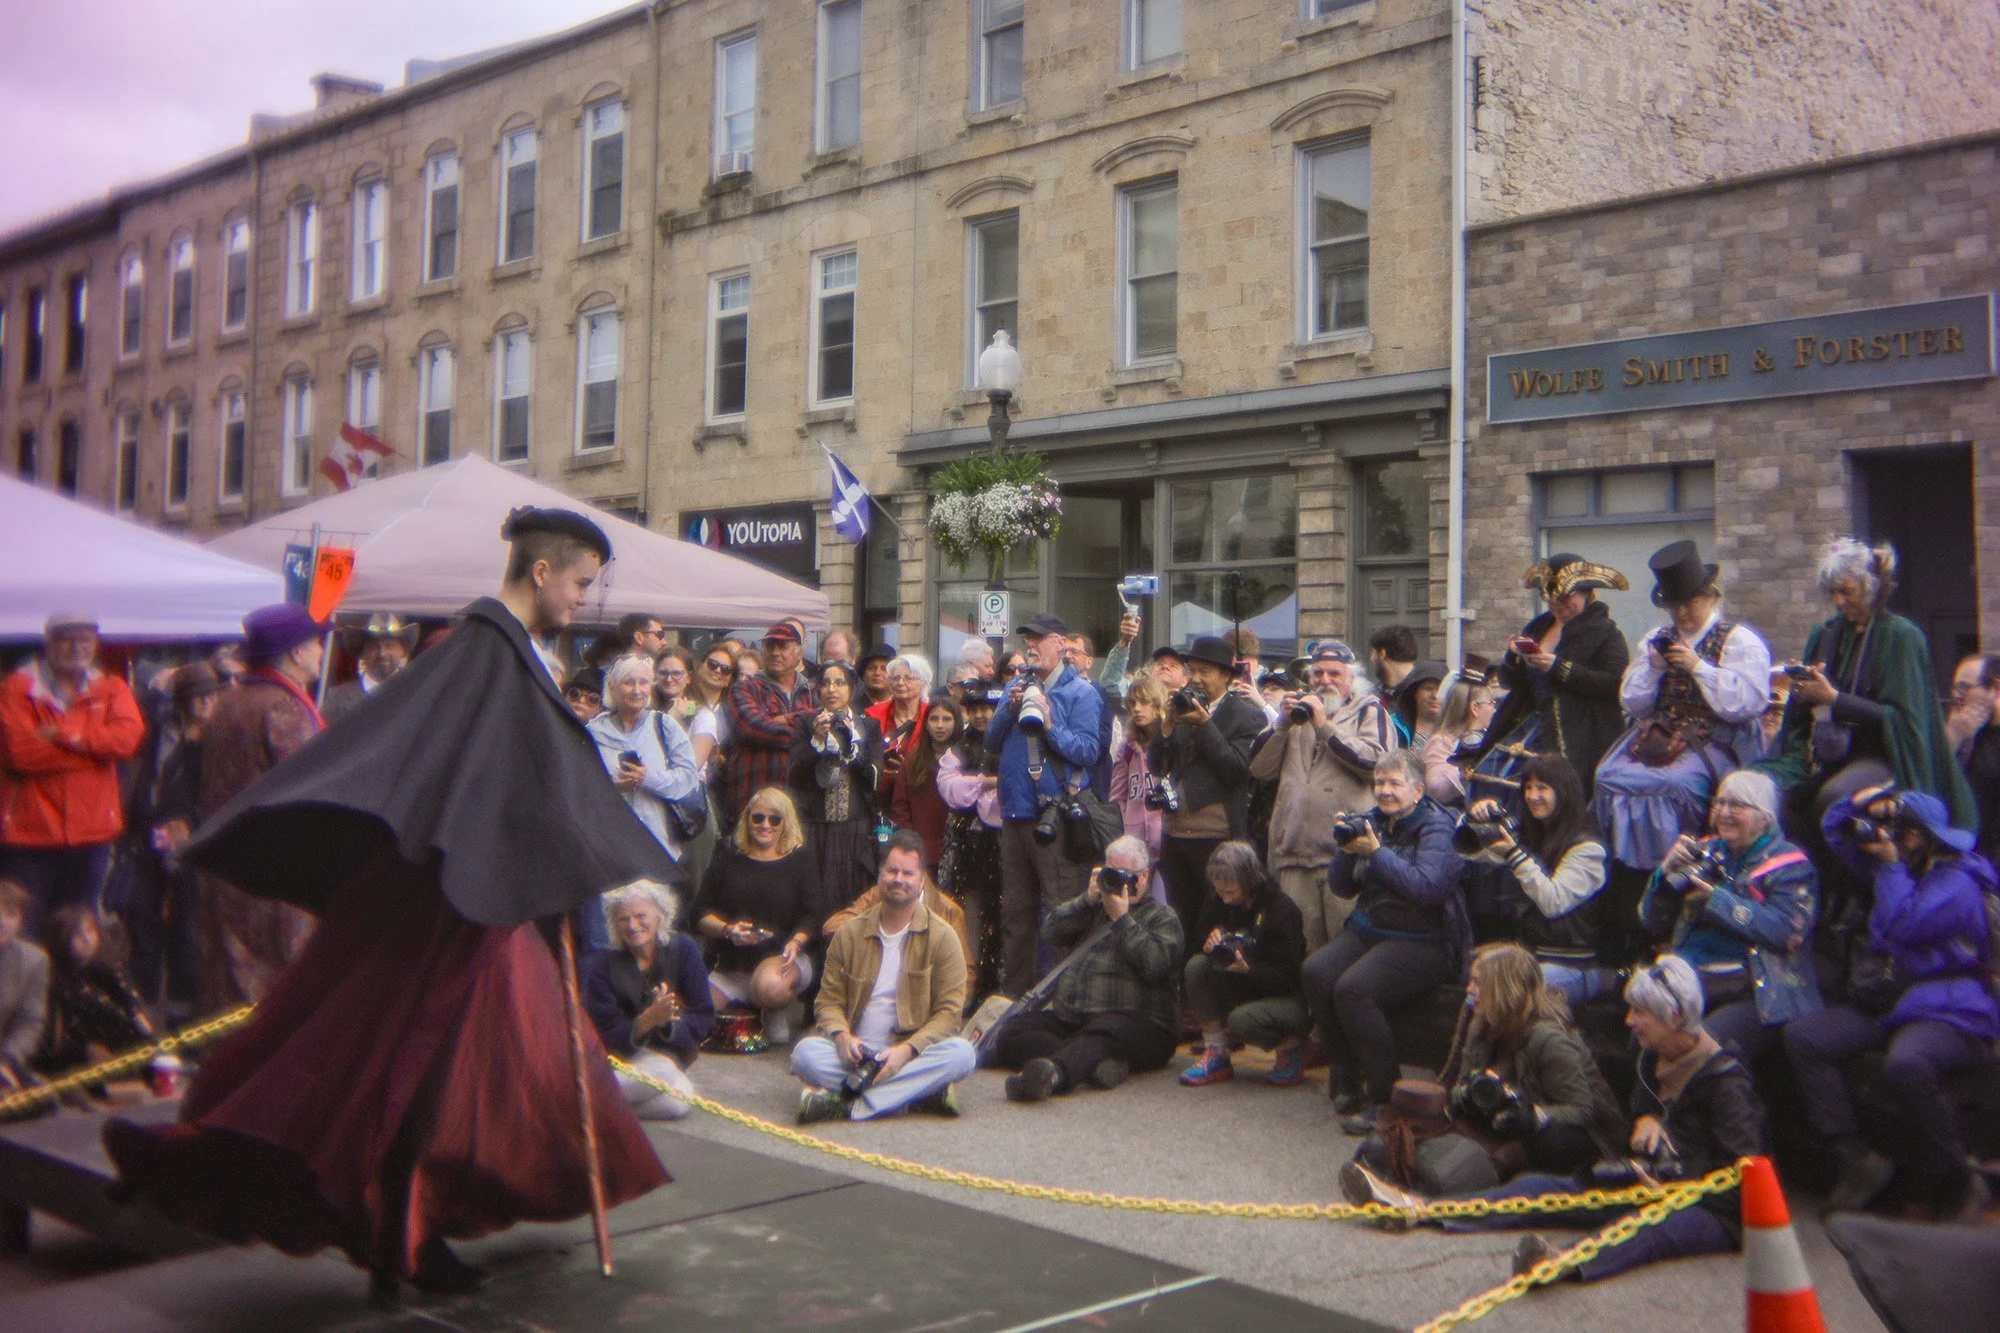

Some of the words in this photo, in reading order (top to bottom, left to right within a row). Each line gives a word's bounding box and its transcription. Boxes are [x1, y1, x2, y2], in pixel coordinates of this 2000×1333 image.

[1508, 367, 1604, 399] WOLFE
[1622, 352, 1729, 388] SMITH
[1752, 346, 1775, 373] &
[1793, 324, 1965, 369] FORSTER
[990, 598, 1000, 610] P
